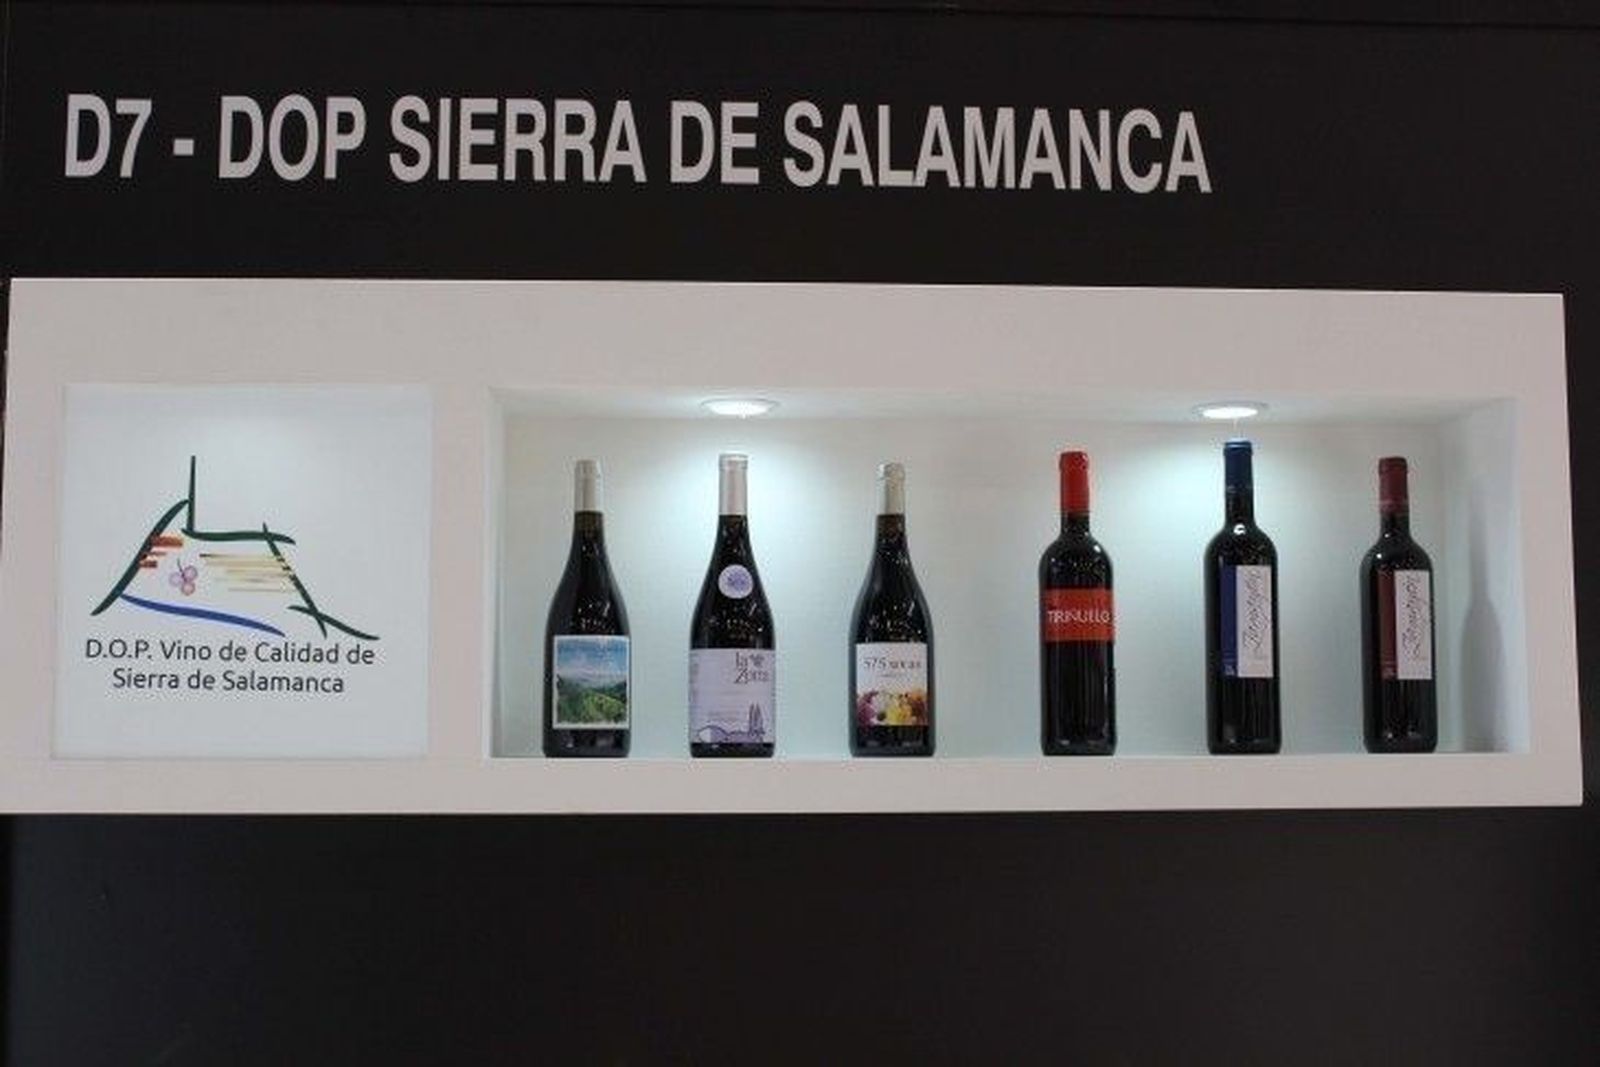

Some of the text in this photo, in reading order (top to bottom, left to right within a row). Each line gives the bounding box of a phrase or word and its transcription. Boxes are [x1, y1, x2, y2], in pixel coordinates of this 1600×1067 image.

[65, 93, 152, 178] D7
[218, 95, 366, 181] DOP
[389, 95, 647, 183] SIERRA
[670, 101, 760, 185] DE
[783, 103, 1212, 194] SALAMANCA
[85, 638, 375, 665] D.O.P. Vino de Calidad de
[112, 667, 344, 693] Sierra de Salamanca
